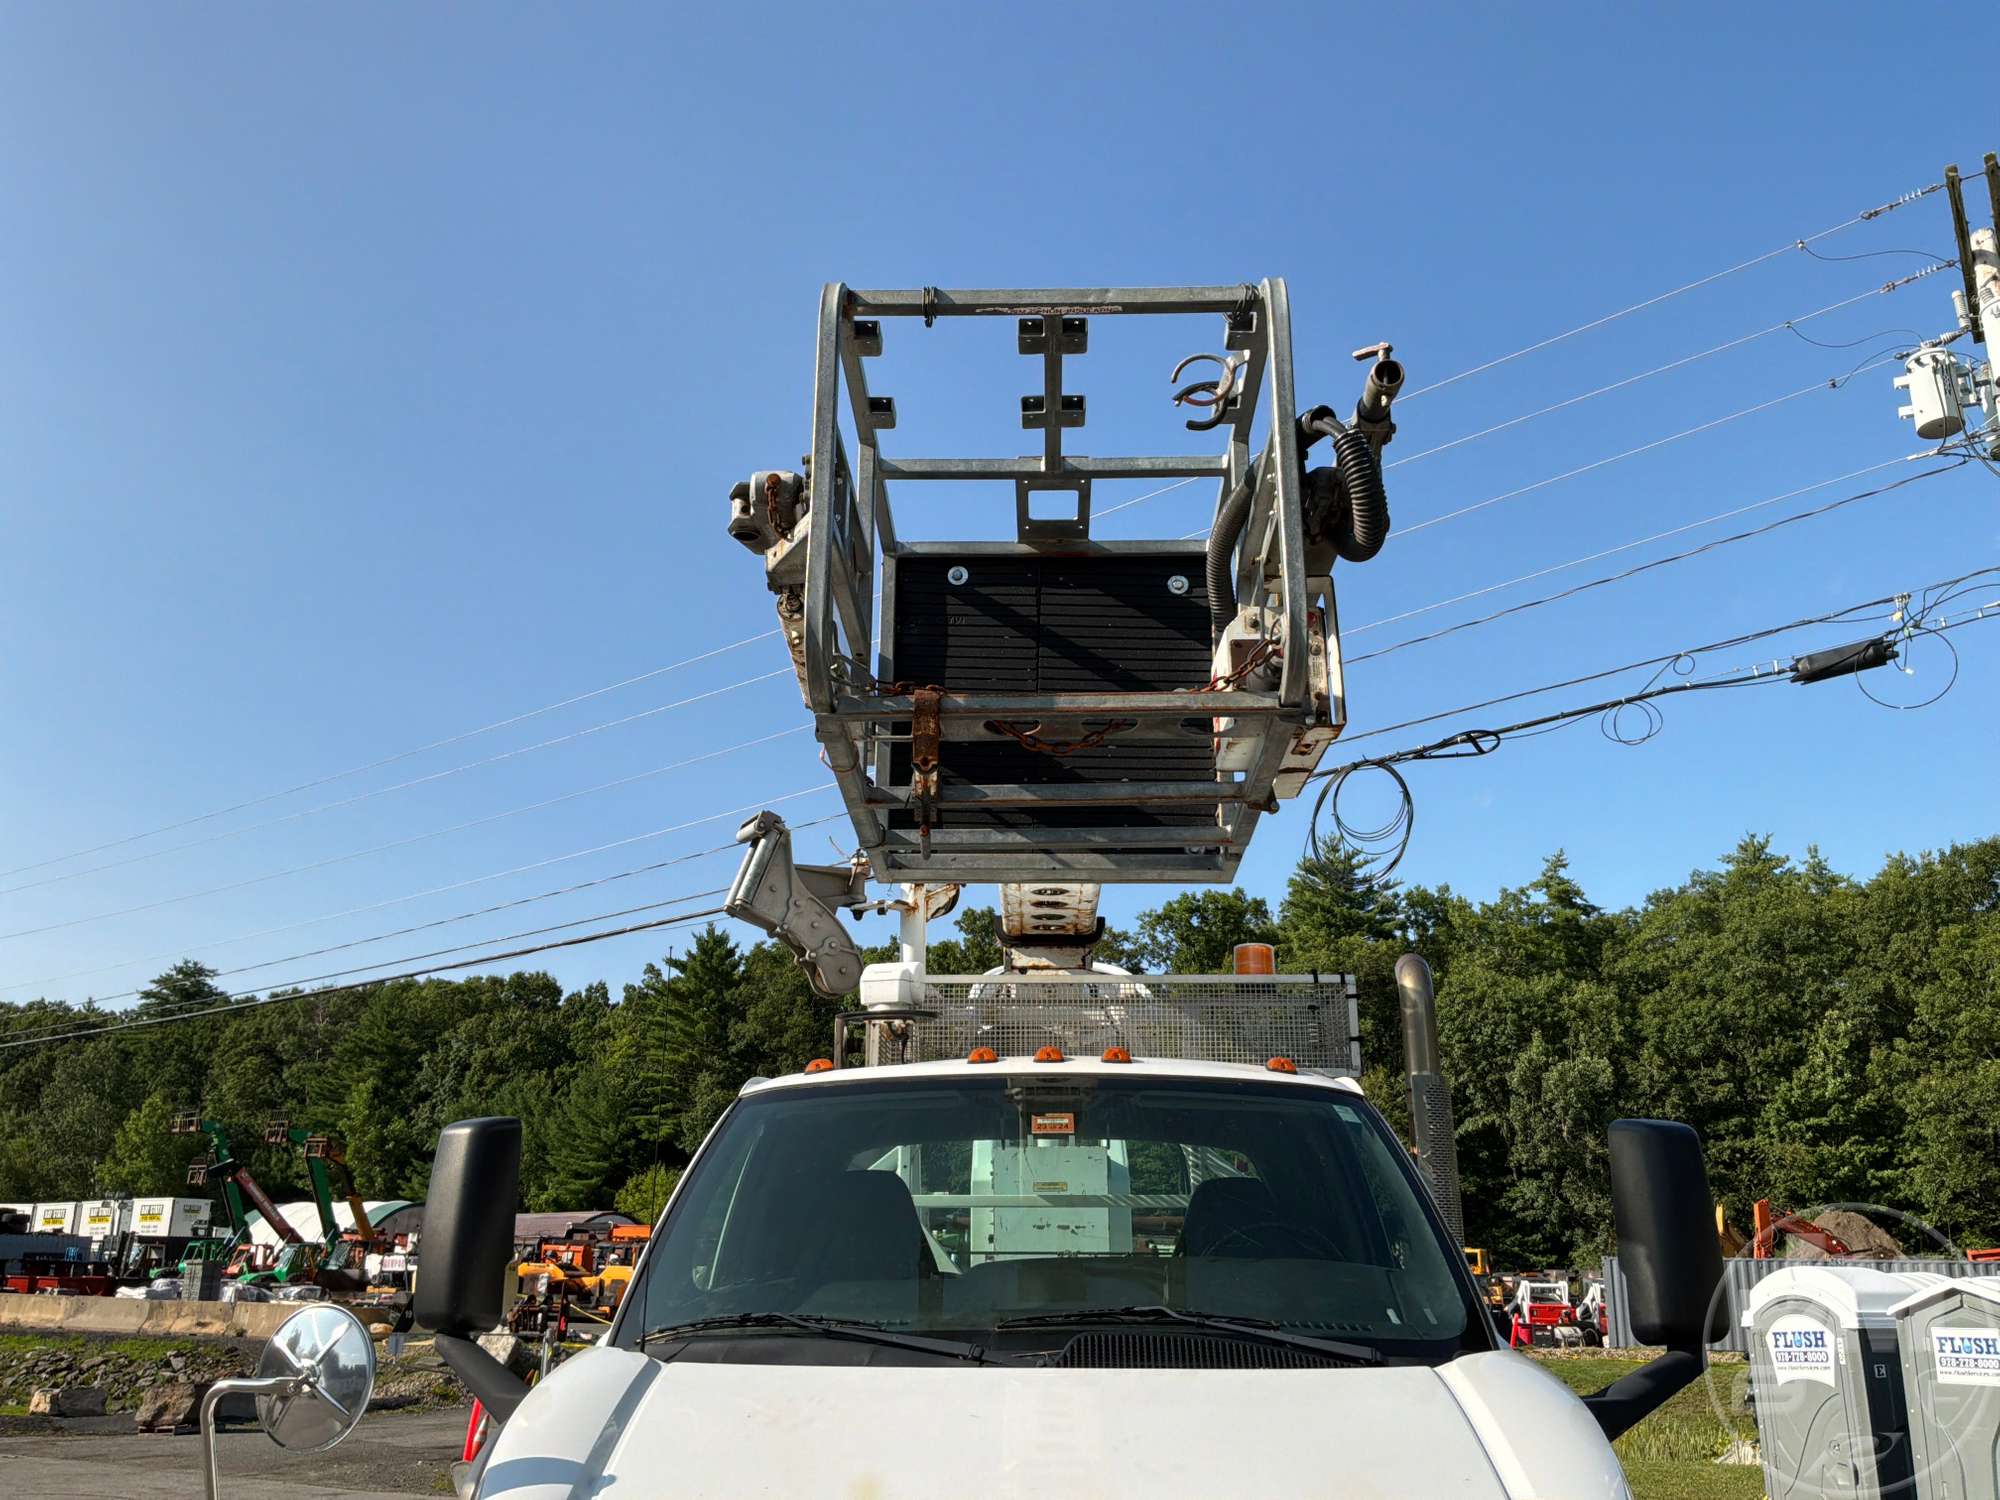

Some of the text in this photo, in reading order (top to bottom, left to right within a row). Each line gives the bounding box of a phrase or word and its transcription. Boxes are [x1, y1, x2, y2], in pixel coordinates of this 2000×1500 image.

[1772, 1330, 1826, 1348] FLUSH
[1936, 1336, 2000, 1355] FLUSH
[1776, 1351, 1828, 1362] 978-778-8000
[1939, 1357, 2000, 1369] 978-778-8000
